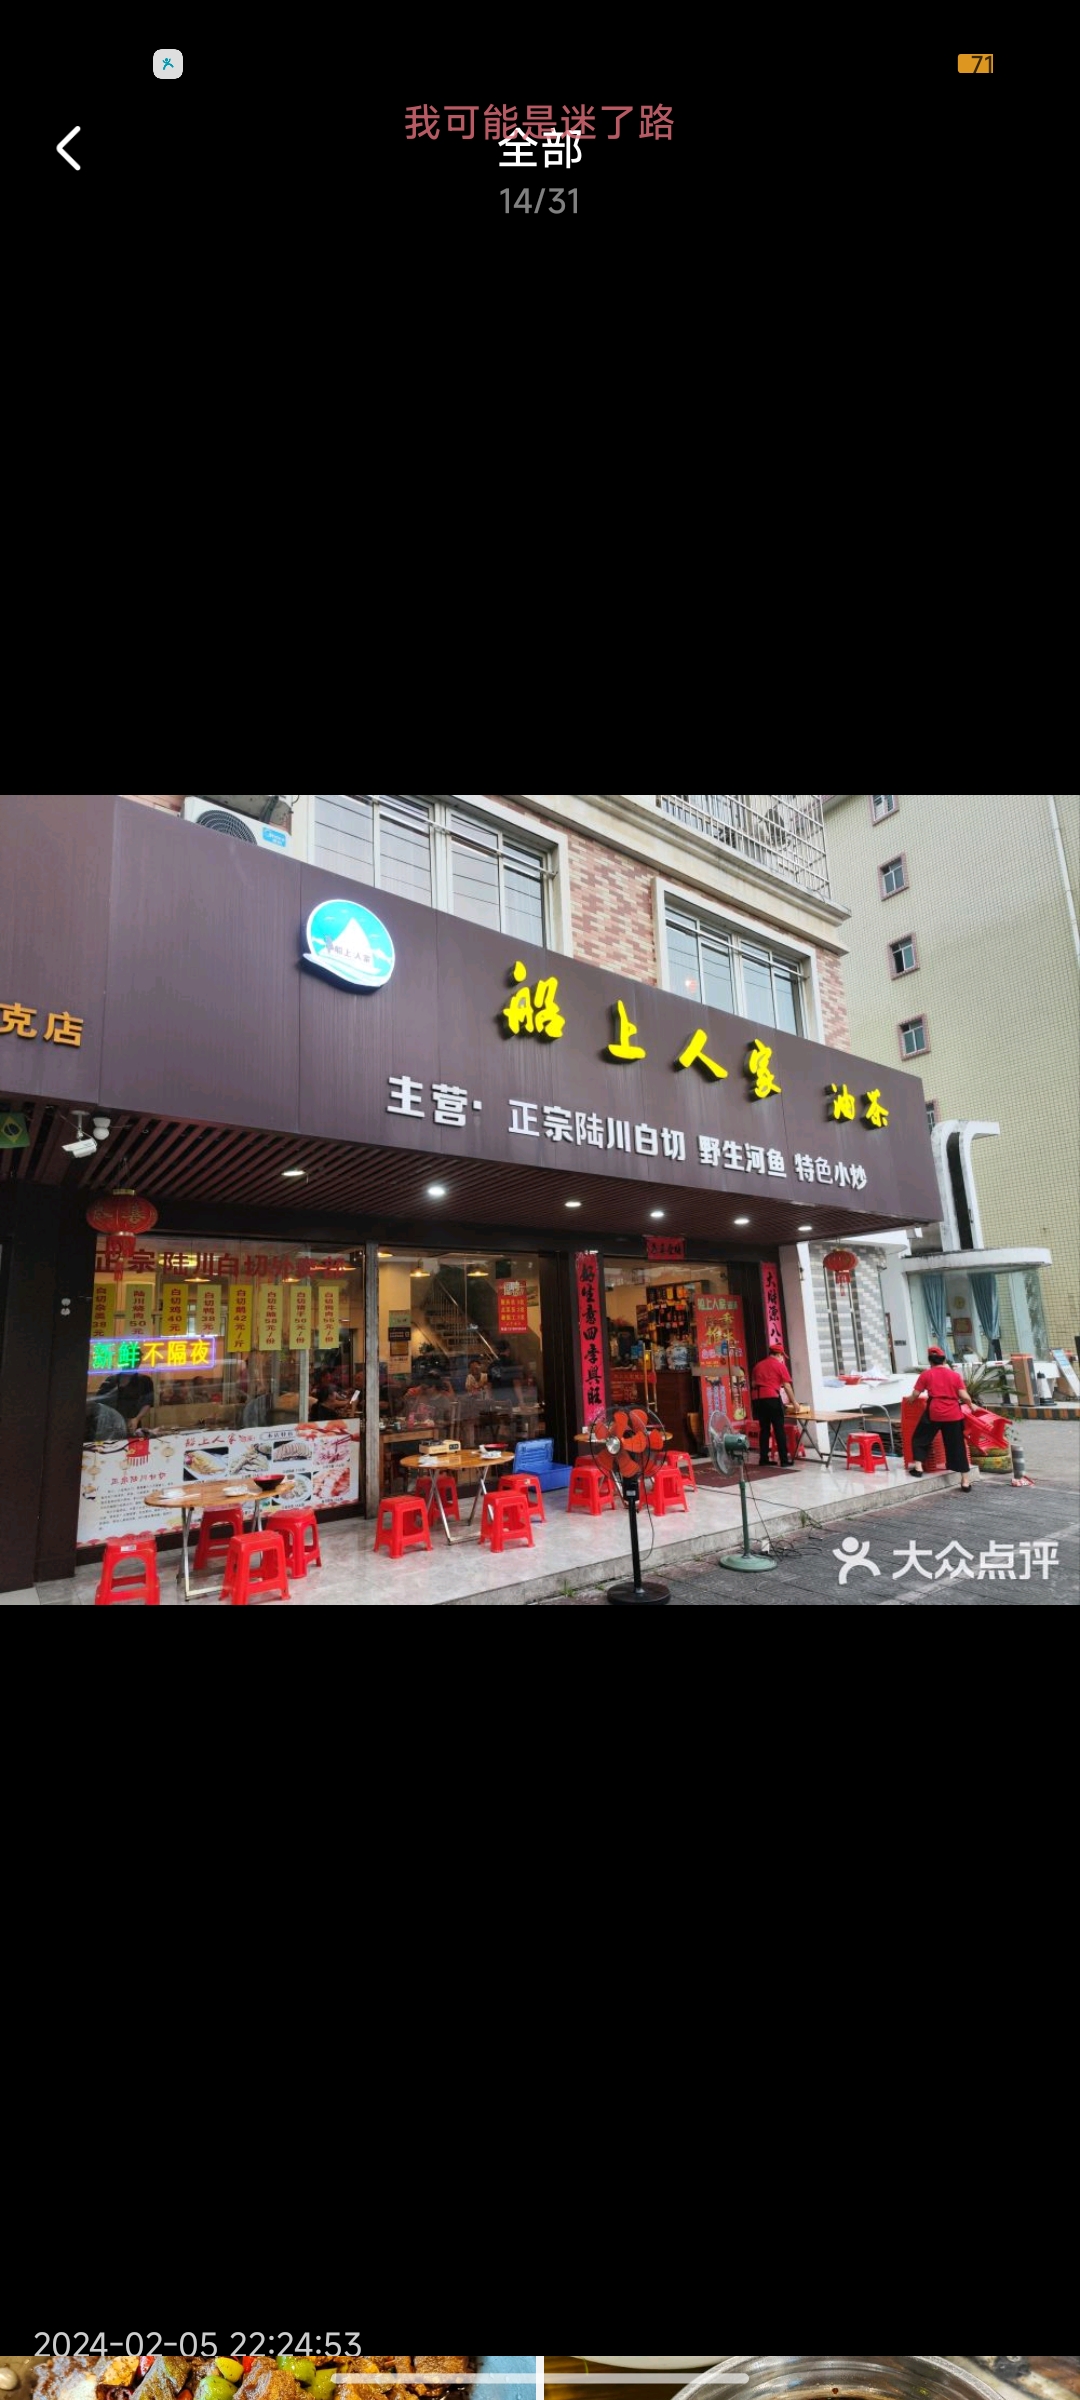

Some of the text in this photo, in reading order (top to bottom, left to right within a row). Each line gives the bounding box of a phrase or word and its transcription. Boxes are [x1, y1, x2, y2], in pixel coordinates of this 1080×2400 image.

[503, 961, 889, 1127] 船上人家 油茶
[508, 1099, 686, 1161] 正宗陆川白切
[699, 1135, 787, 1180] 野生河鱼
[795, 1153, 867, 1191] 特色小炒
[92, 1339, 211, 1370] 新鲜不隔夜
